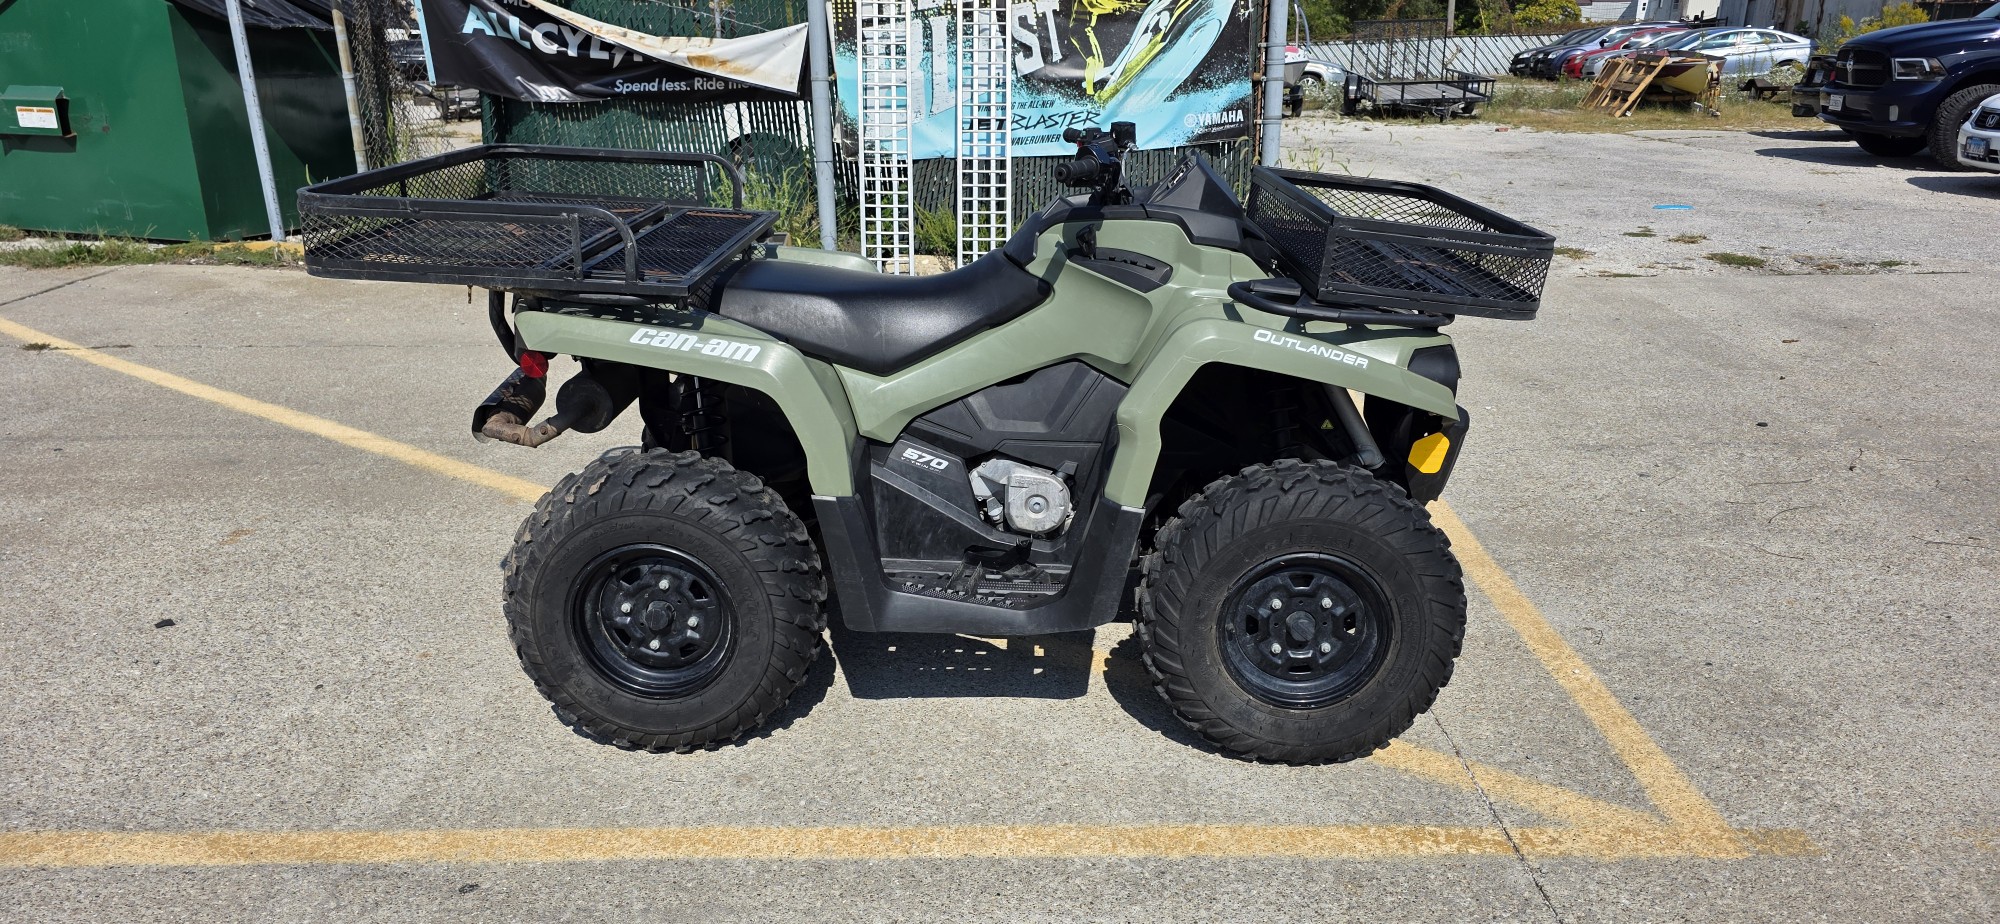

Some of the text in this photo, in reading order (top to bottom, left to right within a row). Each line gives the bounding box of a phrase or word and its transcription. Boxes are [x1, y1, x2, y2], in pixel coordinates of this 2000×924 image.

[614, 78, 659, 94] Spend
[661, 78, 690, 91] less.
[694, 77, 725, 90] Ride
[1028, 99, 1056, 109] ALL-NEW
[1197, 110, 1244, 127] YAMAHA
[1253, 329, 1369, 369] OUTLANDER
[902, 447, 949, 470] 570
